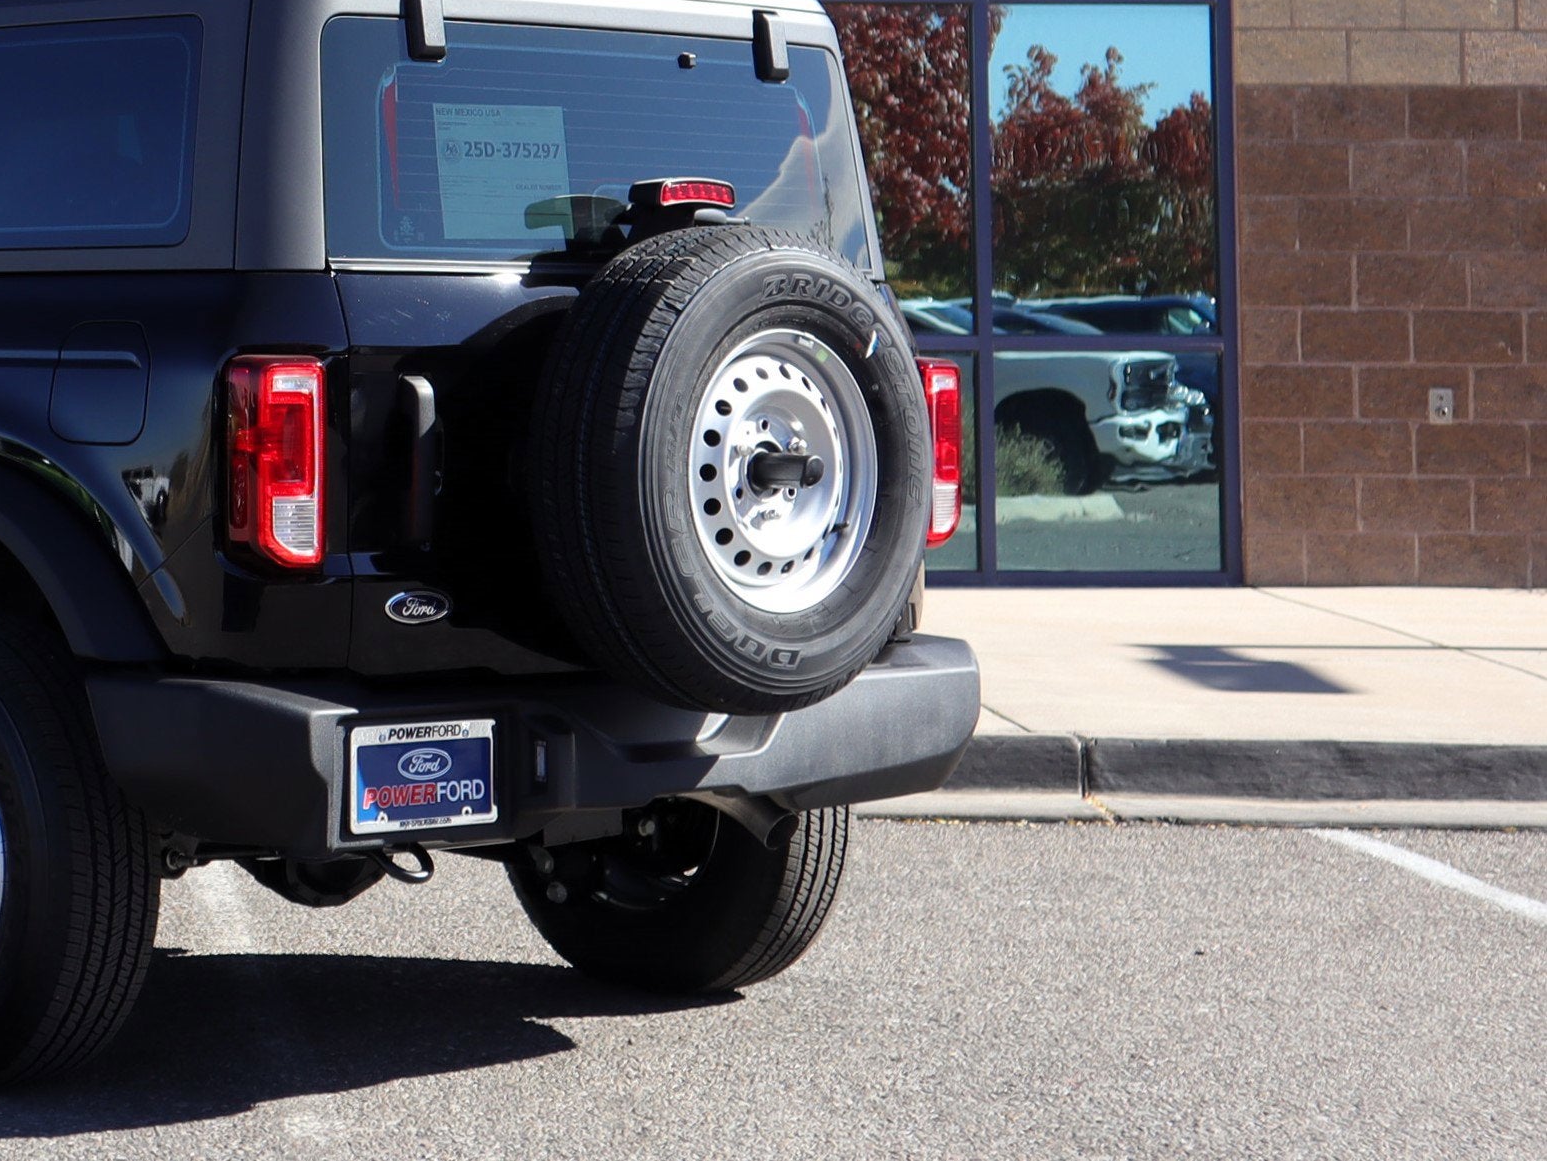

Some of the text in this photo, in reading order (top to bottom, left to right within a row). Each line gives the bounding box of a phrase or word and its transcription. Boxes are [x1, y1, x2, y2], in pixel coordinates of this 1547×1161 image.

[436, 107, 501, 118] NEW MEXICO USA
[463, 141, 560, 159] 25D-375297
[757, 272, 924, 504] BRIDGESTONE
[402, 597, 438, 617] Ford
[387, 724, 462, 741] POWERFORD
[408, 754, 441, 774] Ford
[363, 780, 485, 810] POWERFORD
